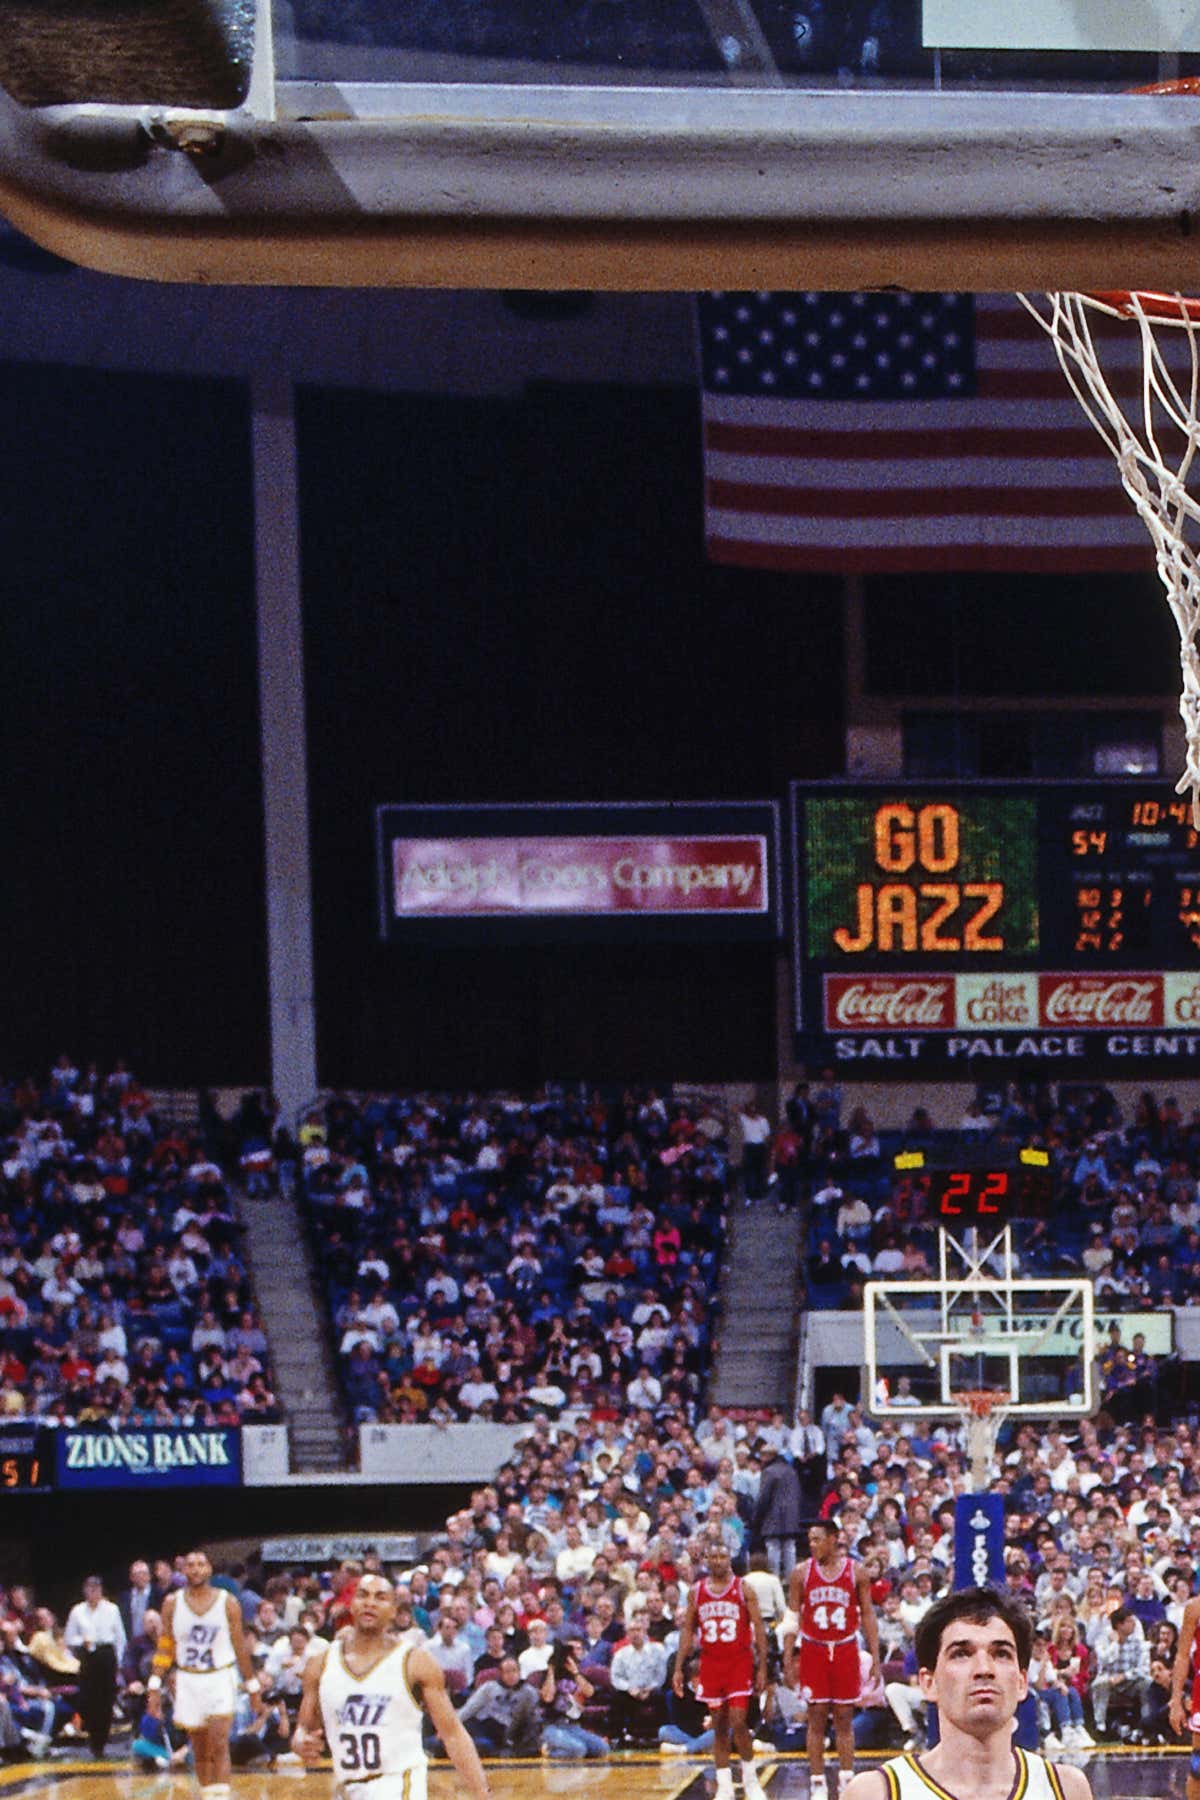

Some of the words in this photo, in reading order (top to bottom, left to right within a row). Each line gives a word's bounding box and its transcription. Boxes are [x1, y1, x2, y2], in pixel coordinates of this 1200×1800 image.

[874, 804, 960, 874] GO
[1072, 830, 1107, 855] 54
[613, 857, 755, 895] Company
[833, 884, 1004, 952] JAZZ
[982, 979, 1026, 1001] diet
[967, 997, 1029, 1024] Coke
[835, 1038, 926, 1060] SALT
[947, 1037, 1085, 1058] PALACE
[940, 1172, 1008, 1215] 22
[65, 1433, 149, 1468] ZIONS
[153, 1432, 230, 1466] BANK
[808, 1586, 851, 1608] SIXERS
[698, 1600, 740, 1621] SIXERS
[812, 1606, 847, 1630] 44
[702, 1619, 737, 1643] 33
[186, 1647, 215, 1669] 24
[339, 1732, 382, 1771] 30
